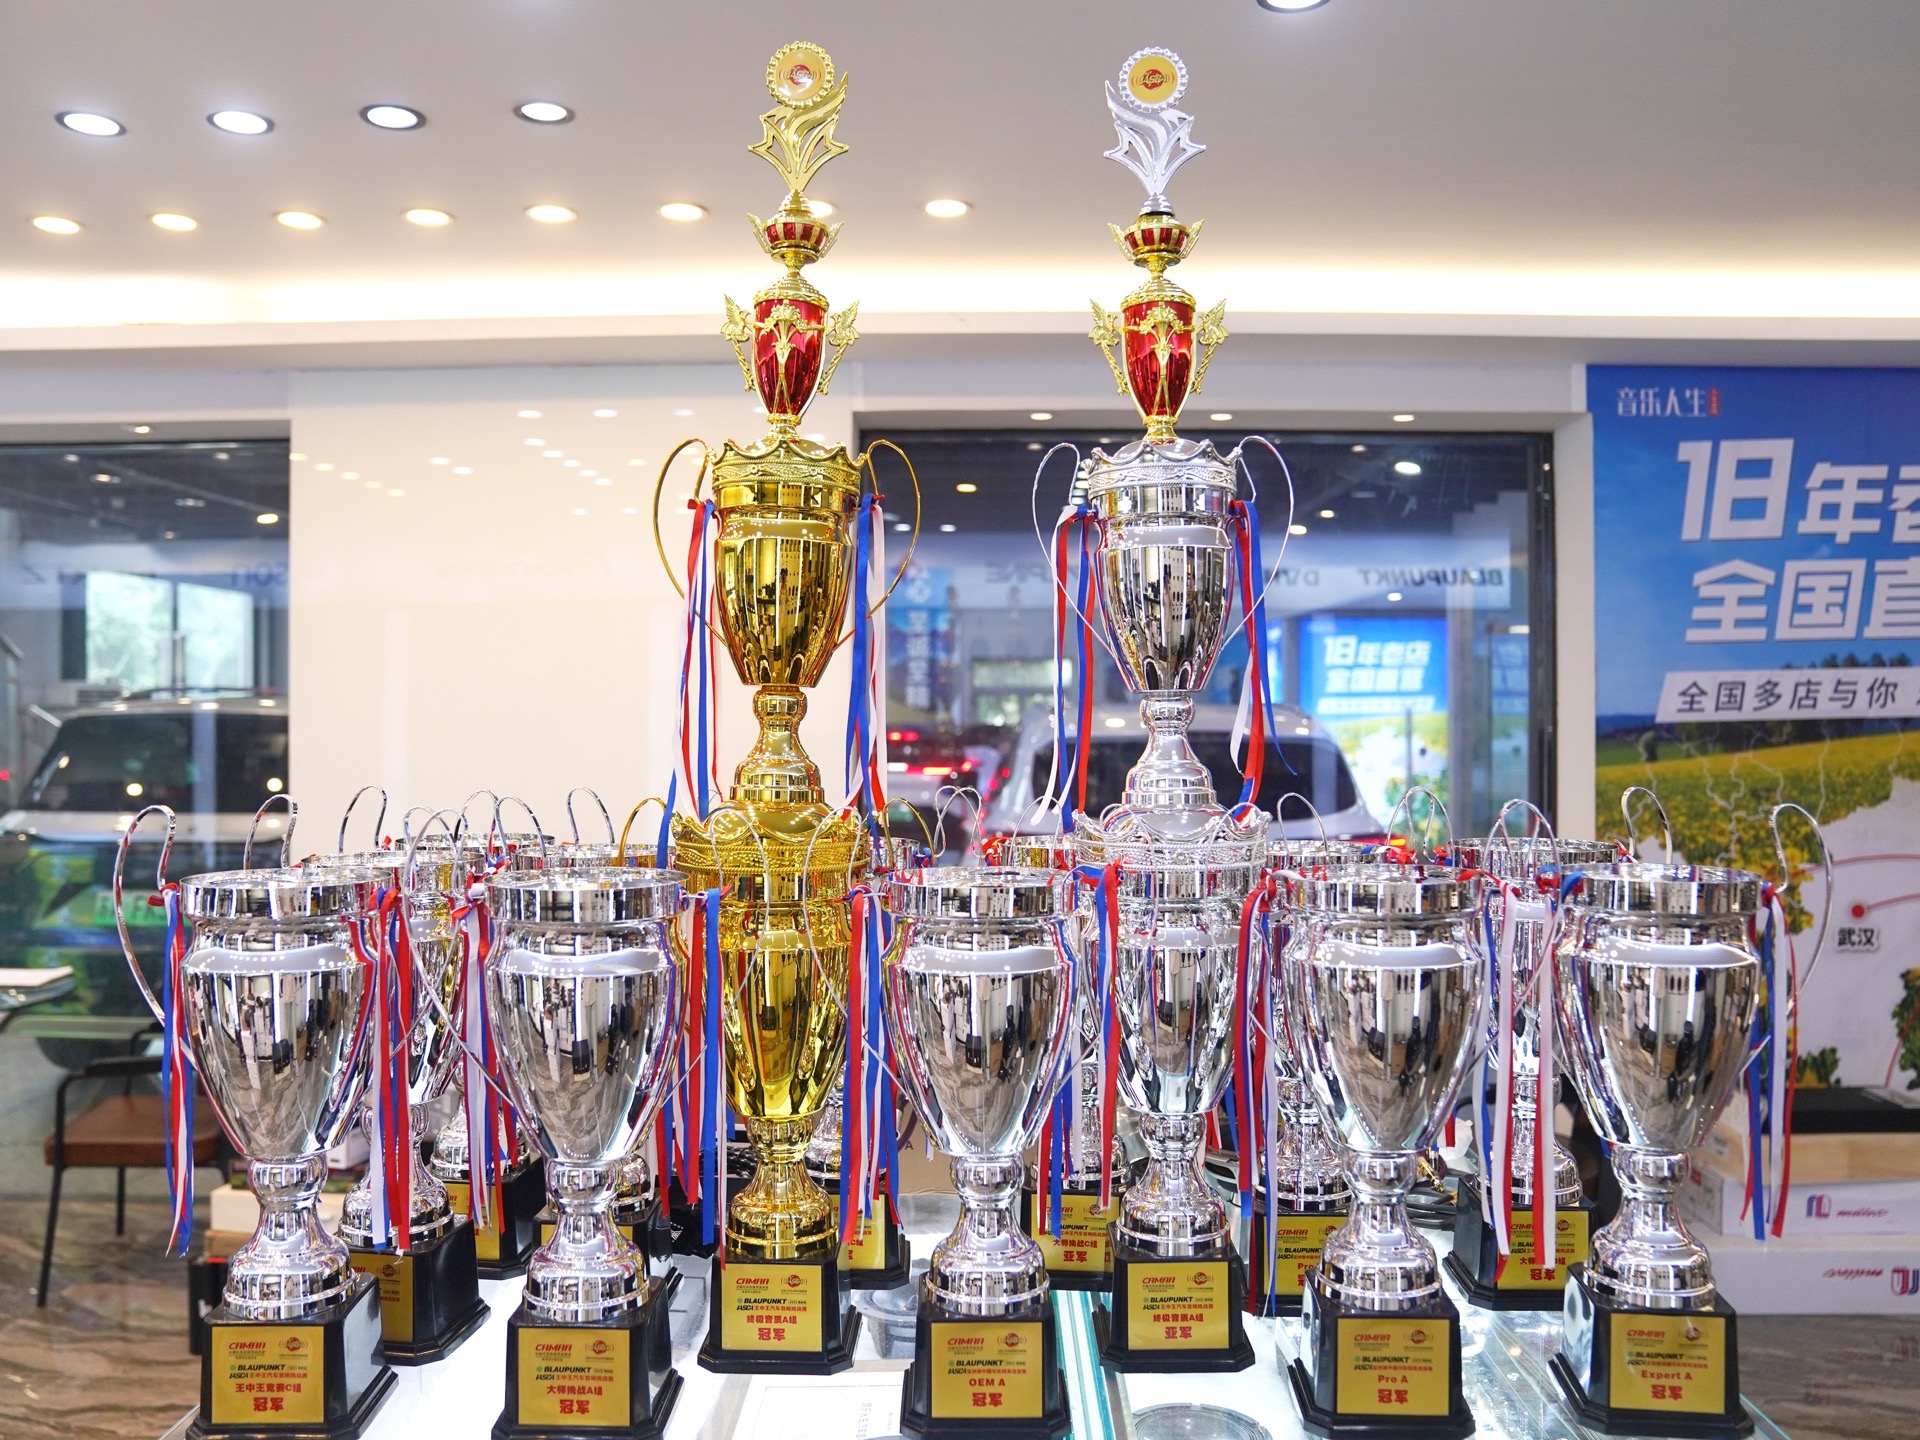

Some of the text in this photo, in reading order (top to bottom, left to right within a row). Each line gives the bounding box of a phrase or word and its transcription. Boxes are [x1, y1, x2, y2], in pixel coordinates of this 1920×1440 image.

[1617, 387, 1707, 417] 音乐人生
[1676, 677, 1898, 713] 全国多店与你
[1838, 927, 1876, 947] 武汉
[1064, 1250, 1087, 1262] 亚军
[1530, 1268, 1556, 1280] 冠军
[746, 1314, 798, 1324] 终极音质A组
[1153, 1314, 1204, 1322] 终极音质A组
[758, 1328, 786, 1341] 冠军
[1165, 1326, 1192, 1339] 亚军
[1378, 1375, 1408, 1383] Pro A
[1642, 1370, 1692, 1380] Expert A
[236, 1383, 302, 1392] 王中王竞赛C组
[969, 1378, 1006, 1386] OEM A
[547, 1385, 602, 1396] 大师挑战A组
[1378, 1389, 1408, 1404] 冠军
[1652, 1384, 1682, 1400] 冠军
[254, 1397, 284, 1412] 冠军
[972, 1392, 1002, 1406] 冠军
[560, 1399, 590, 1414] 冠军
